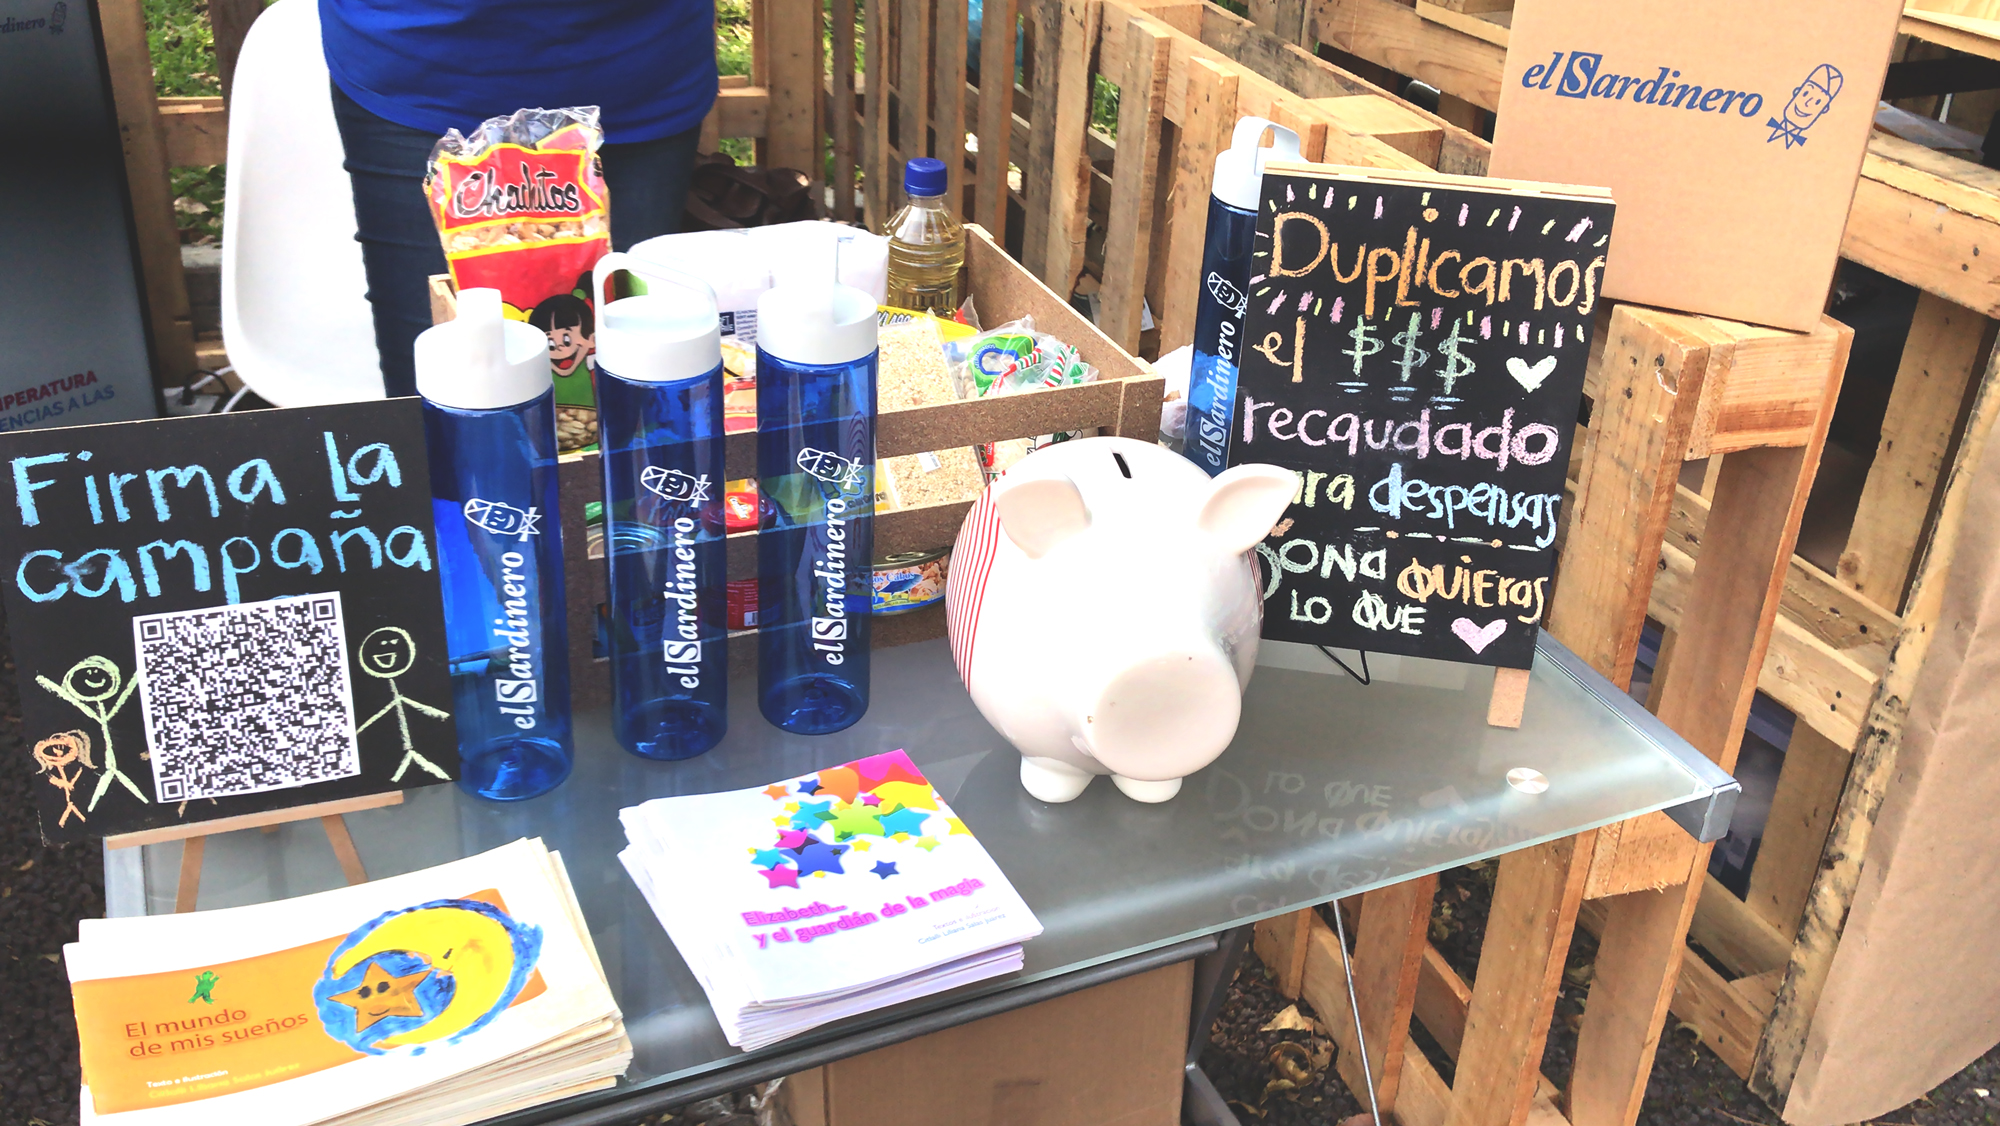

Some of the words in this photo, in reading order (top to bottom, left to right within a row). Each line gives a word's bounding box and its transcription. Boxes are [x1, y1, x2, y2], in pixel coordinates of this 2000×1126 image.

[0, 16, 46, 34] dinero
[1268, 207, 1605, 320] Duplicamos
[1252, 316, 1306, 383] el
[0, 370, 98, 412] PERATURA
[68, 396, 81, 412] A
[82, 384, 115, 407] LAS
[1242, 396, 1560, 471] recaudado
[9, 450, 287, 527] Firma
[1368, 463, 1562, 549] despensas
[16, 508, 432, 605] campaña
[1290, 588, 1332, 625] LO
[1352, 589, 1427, 636] QUE
[752, 932, 768, 949] y
[771, 926, 793, 943] el
[794, 911, 879, 943] guardián
[880, 902, 908, 919] de
[905, 895, 930, 910] la
[929, 878, 986, 903] magia
[125, 1021, 147, 1038] El
[155, 1009, 247, 1035] mundo
[129, 1041, 163, 1057] de
[170, 1034, 215, 1052] mis
[222, 1013, 310, 1043] sueños
